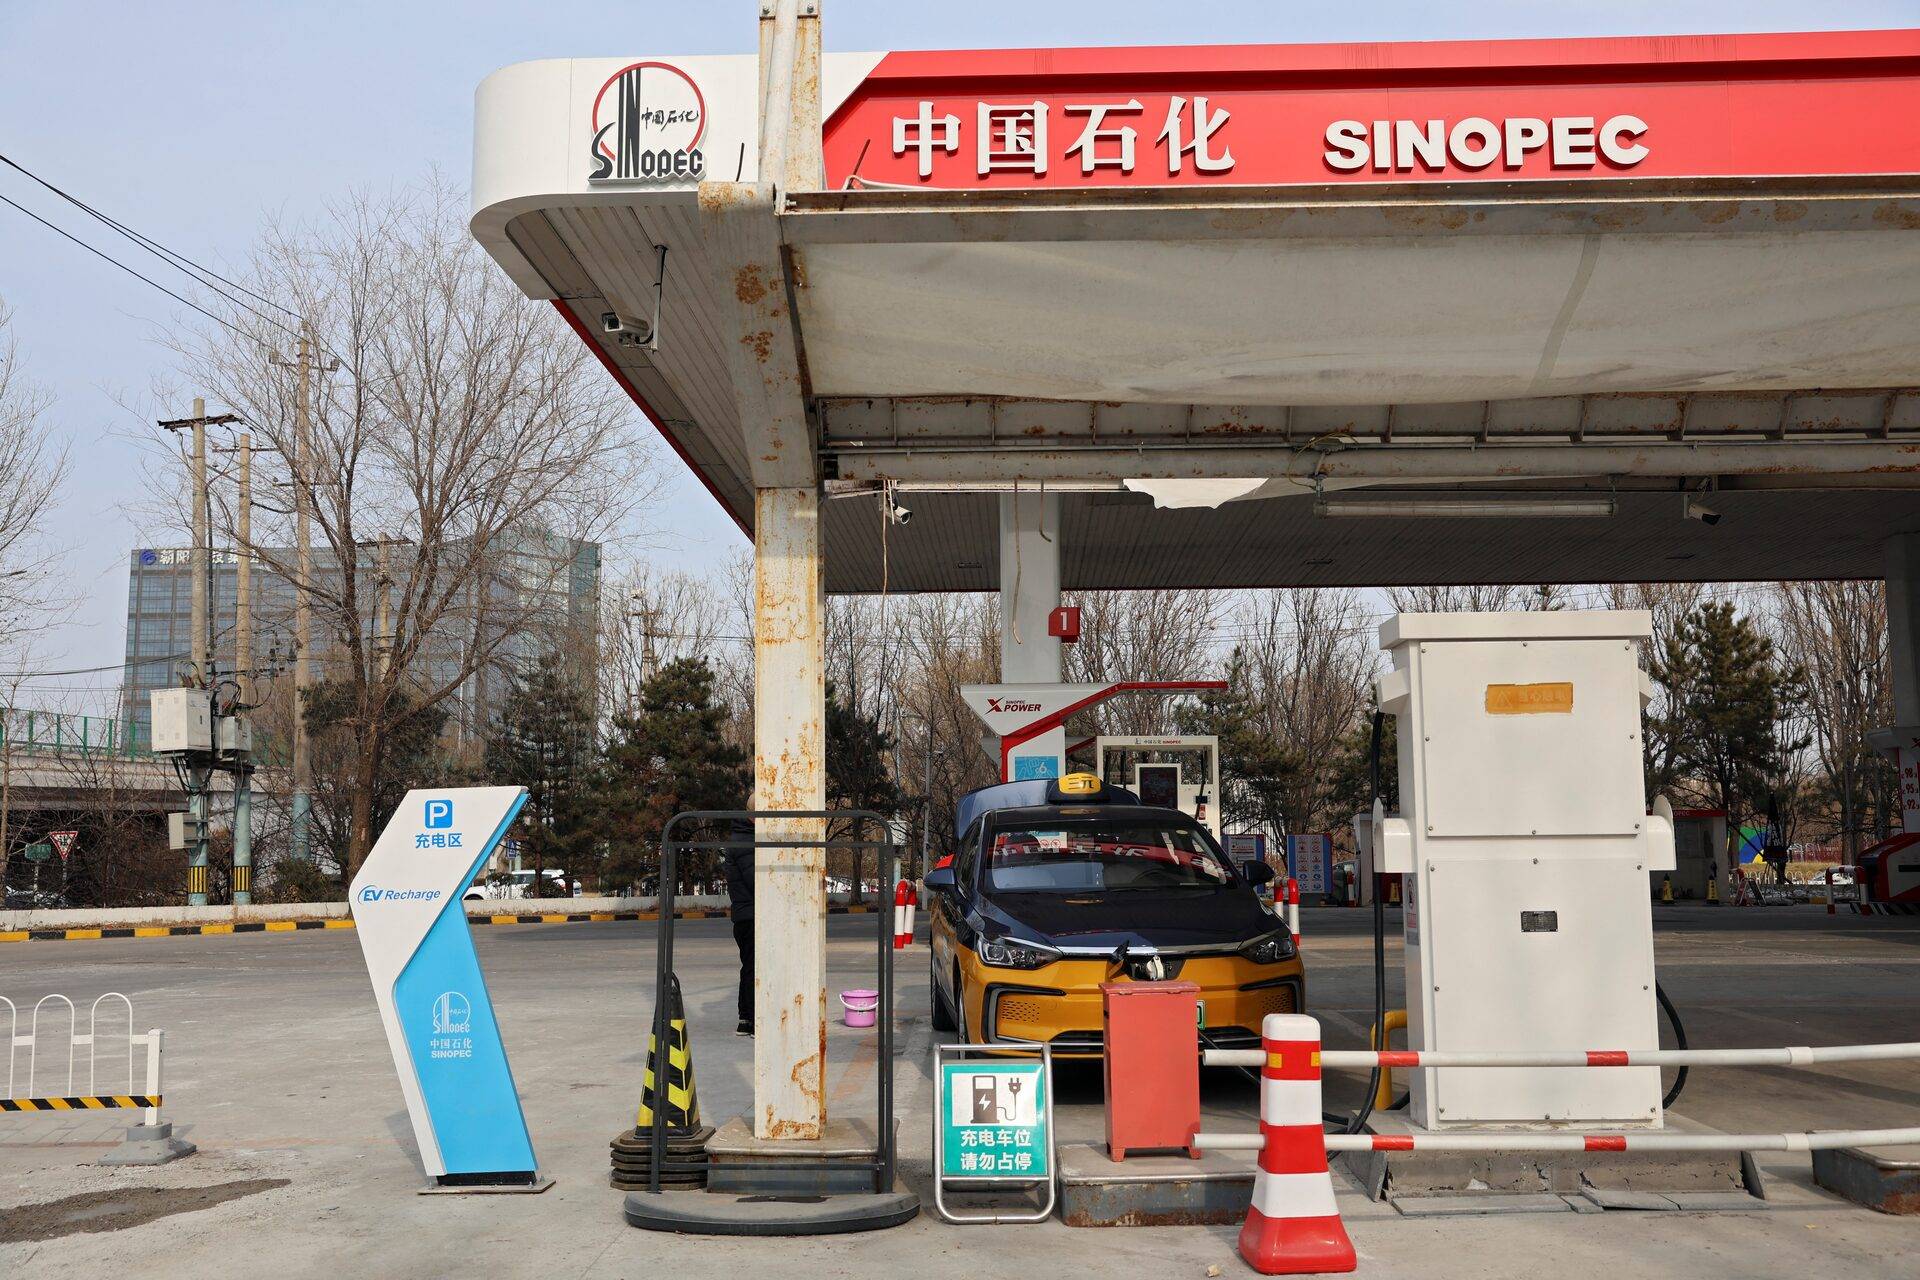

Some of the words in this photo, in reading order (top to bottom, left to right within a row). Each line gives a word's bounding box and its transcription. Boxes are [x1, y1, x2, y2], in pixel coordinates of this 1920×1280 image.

[640, 106, 700, 132] 中国石化
[891, 94, 1236, 178] 中国石化
[1323, 114, 1650, 172] SINOPEC
[1059, 611, 1069, 632] 1
[1004, 703, 1042, 713] POWER
[415, 832, 463, 849] 充电区
[363, 889, 384, 902] EV
[385, 888, 441, 902] Recharge
[430, 1038, 473, 1049] 中国石化
[431, 1049, 472, 1059] SINOPEC
[960, 1128, 1032, 1148] 充电车位
[960, 1152, 1032, 1171] 请勿占停
